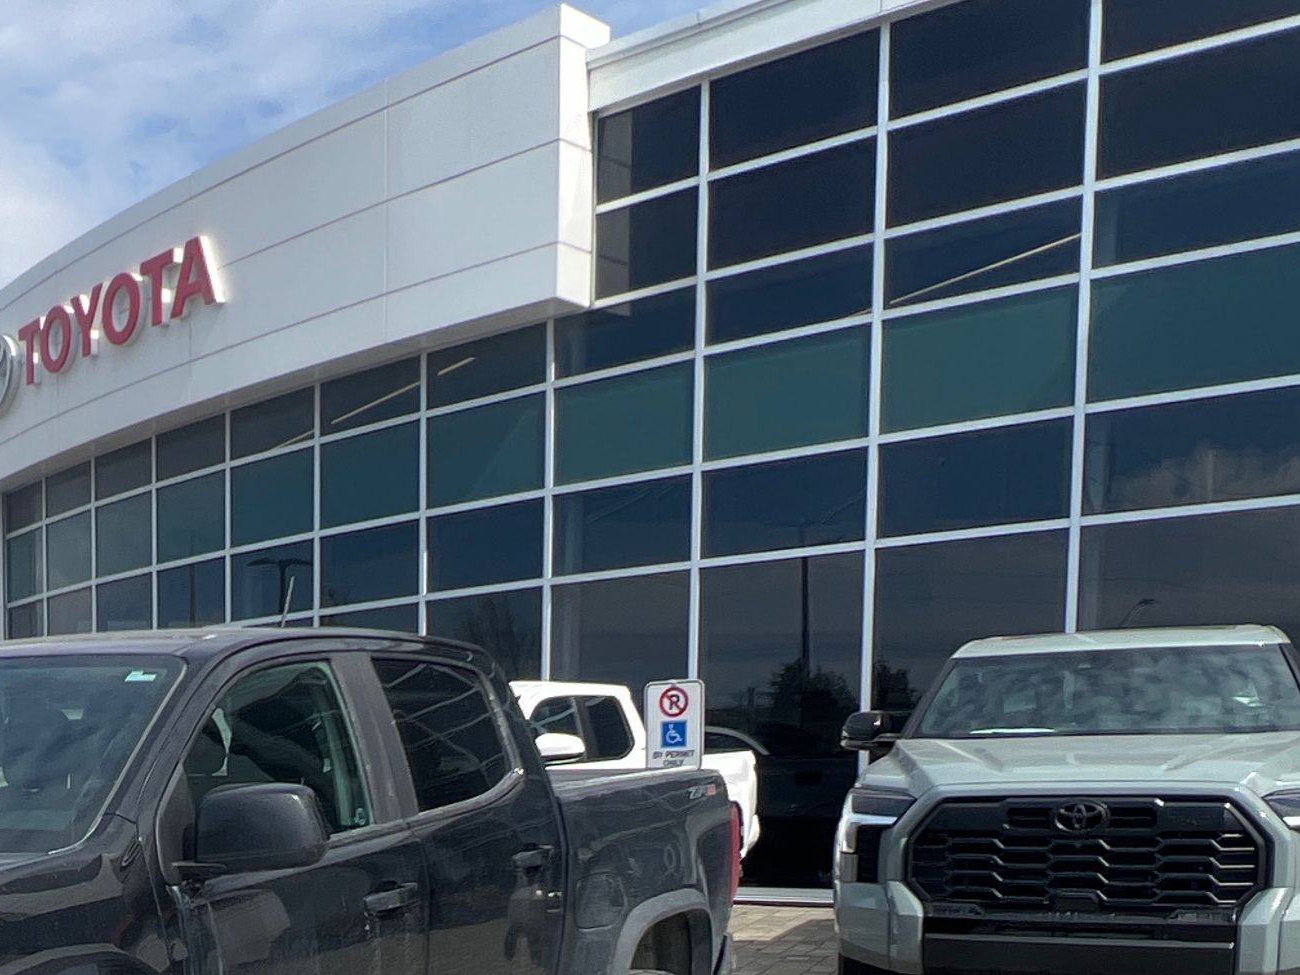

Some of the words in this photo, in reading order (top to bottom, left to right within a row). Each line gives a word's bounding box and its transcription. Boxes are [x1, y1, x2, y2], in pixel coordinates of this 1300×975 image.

[18, 236, 224, 385] TOYOTA
[652, 751, 663, 759] BY
[665, 749, 695, 758] PERMIT
[662, 759, 684, 768] ONLY
